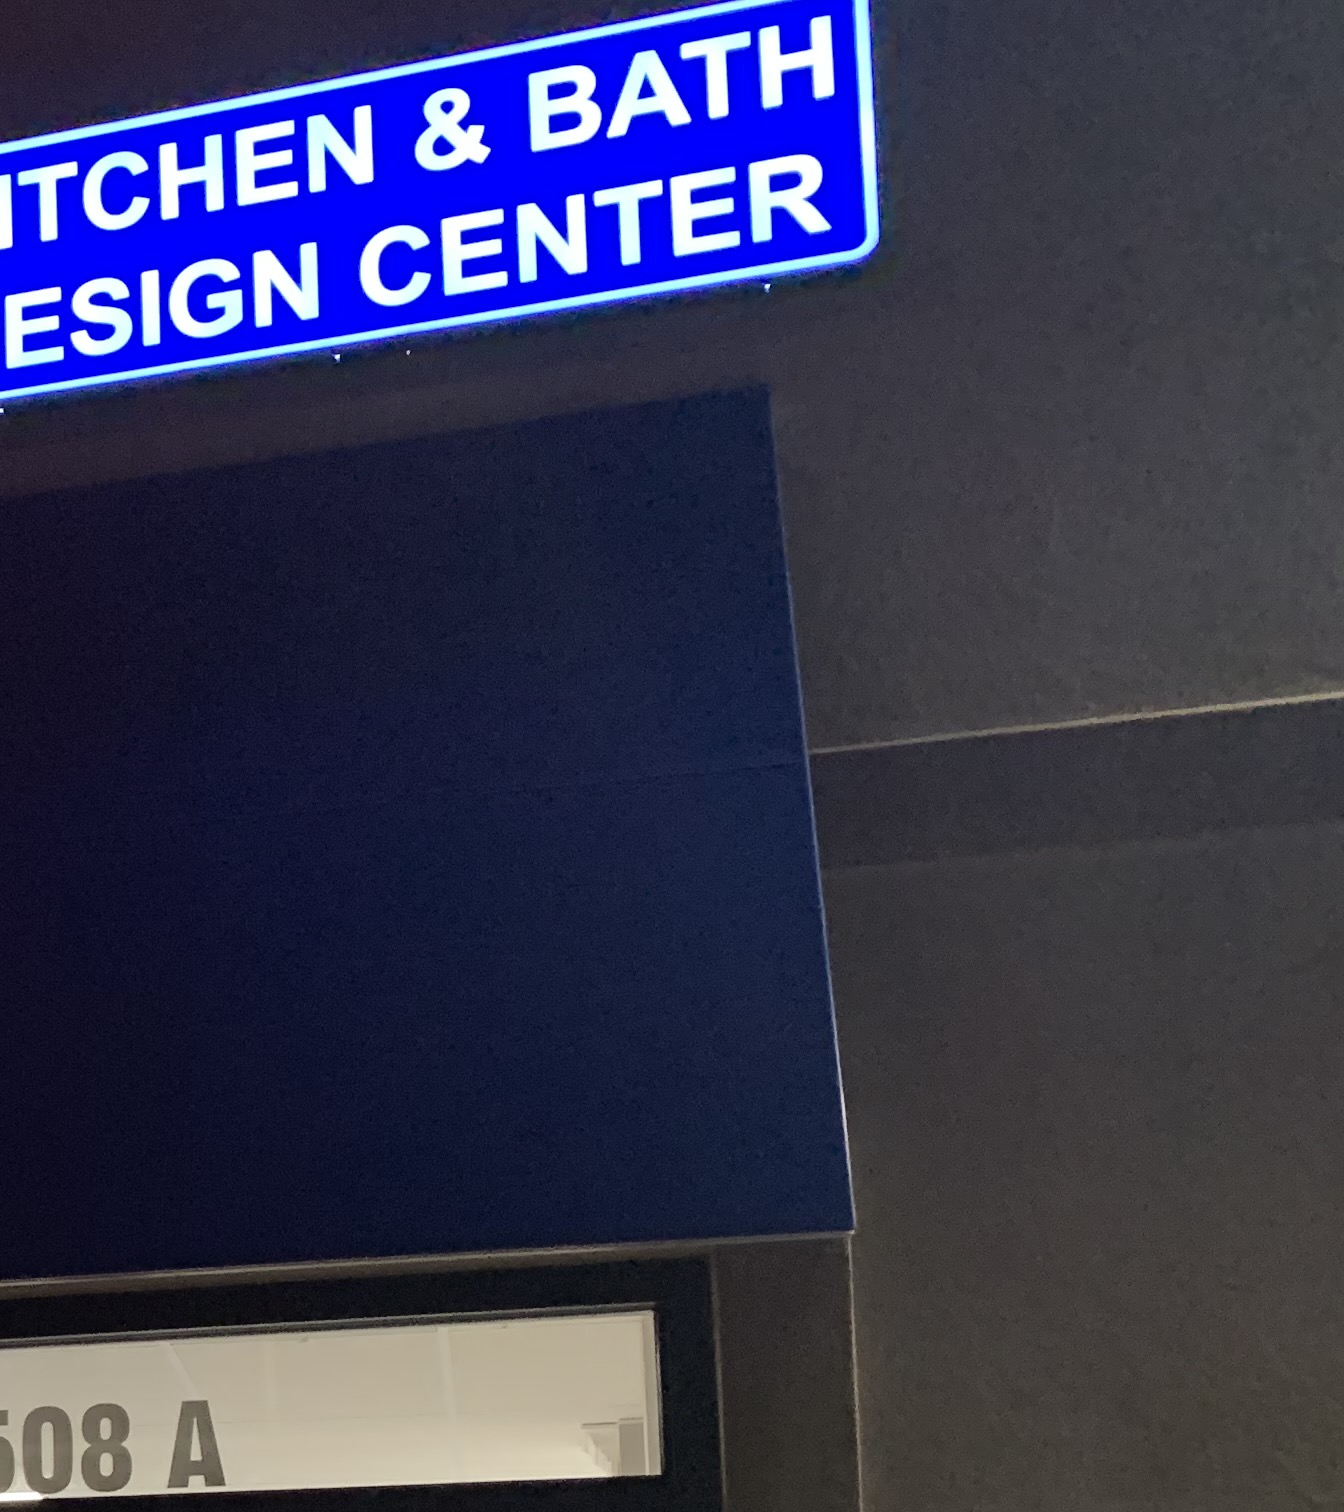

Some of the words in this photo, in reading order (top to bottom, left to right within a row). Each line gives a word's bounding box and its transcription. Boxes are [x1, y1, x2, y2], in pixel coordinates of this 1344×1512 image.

[414, 86, 491, 170] &
[528, 14, 835, 153] BATH
[359, 153, 832, 307] CENTER
[167, 1399, 226, 1489] A
